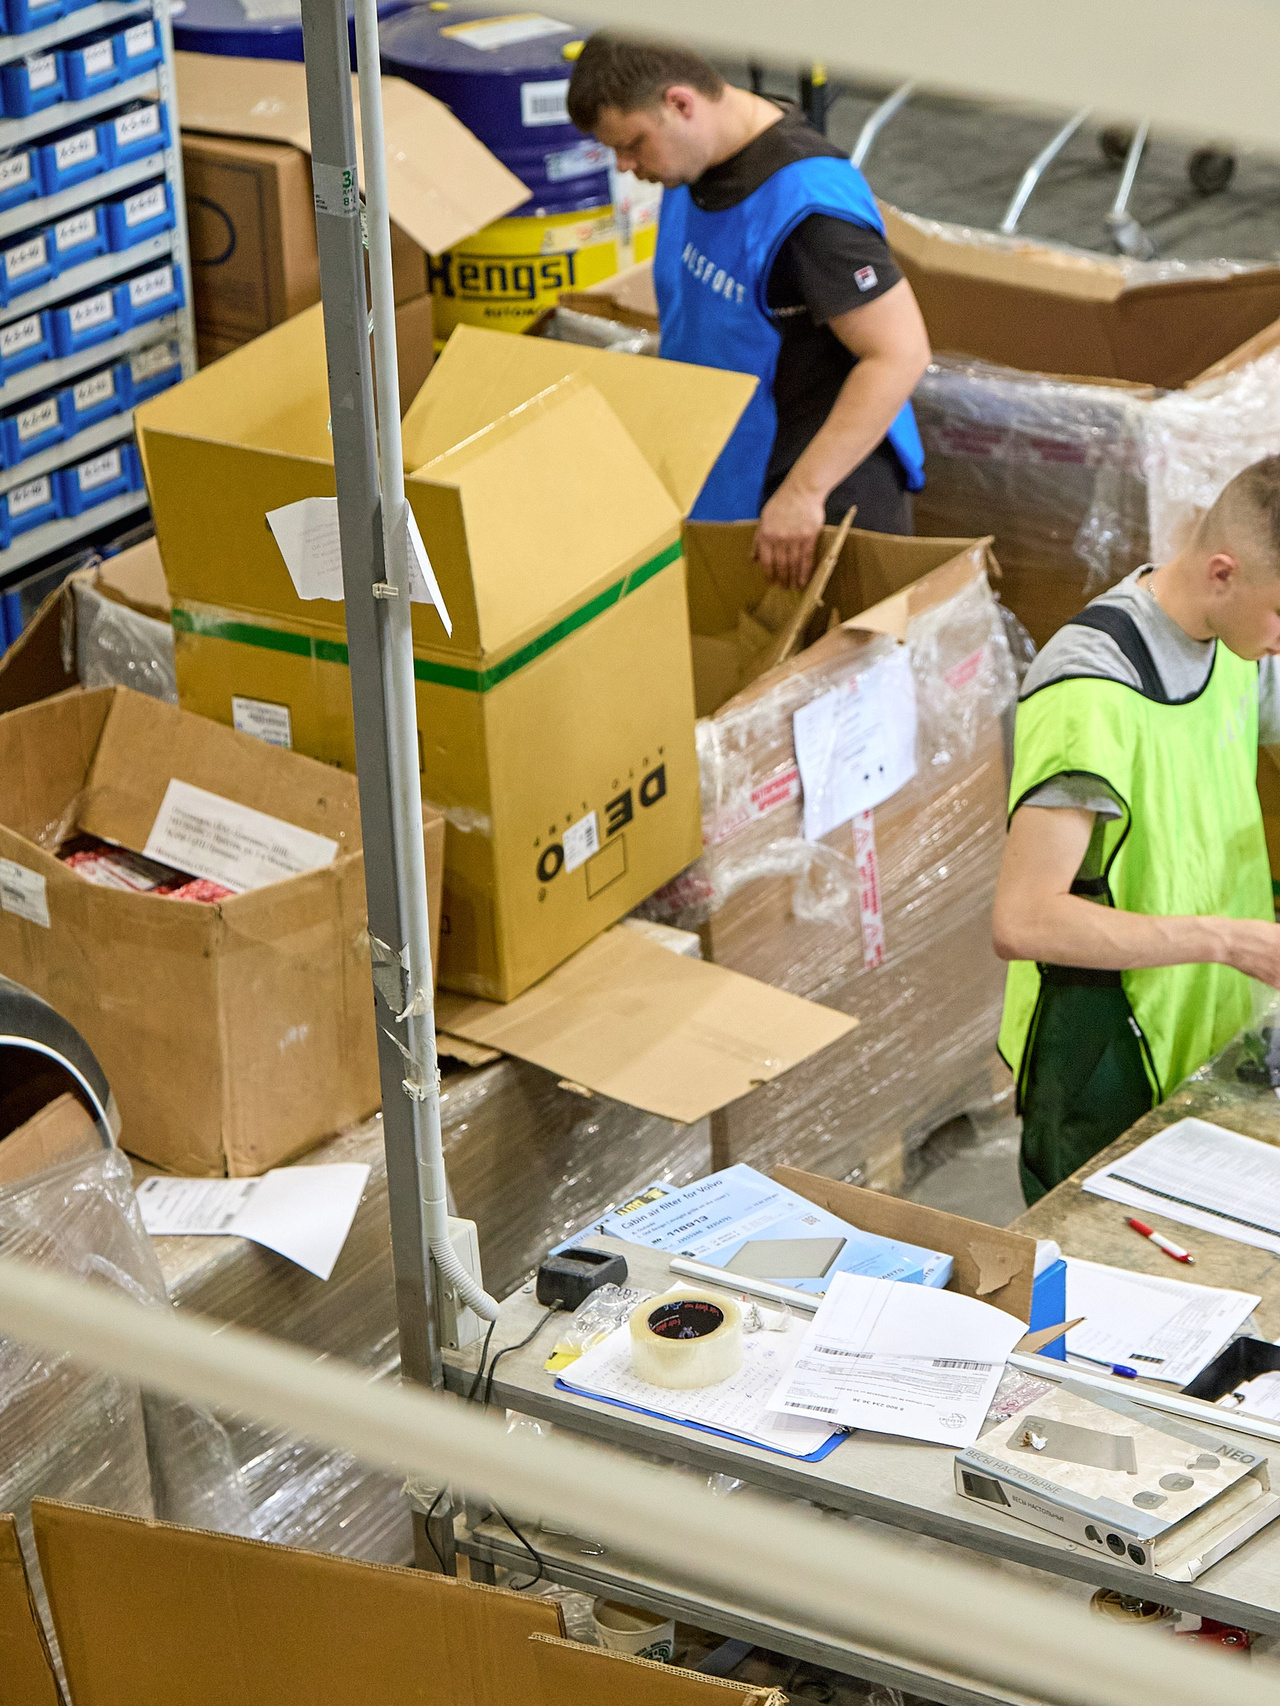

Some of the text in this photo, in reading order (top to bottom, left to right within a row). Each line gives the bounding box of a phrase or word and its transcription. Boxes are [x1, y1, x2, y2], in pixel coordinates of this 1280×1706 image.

[537, 762, 666, 882] DEO
[621, 1211, 648, 1230] Cabin
[649, 1208, 660, 1218] air
[660, 1197, 682, 1212] filter
[683, 1190, 697, 1200] for
[698, 1179, 723, 1195] Volvo
[965, 1450, 1062, 1495] ВЕСЫ НАСТОЛЬНЫЕ
[1215, 1444, 1256, 1464] NEO
[1012, 1495, 1065, 1522] ВЕСЫ НАСТОЛЬНЫЕ
